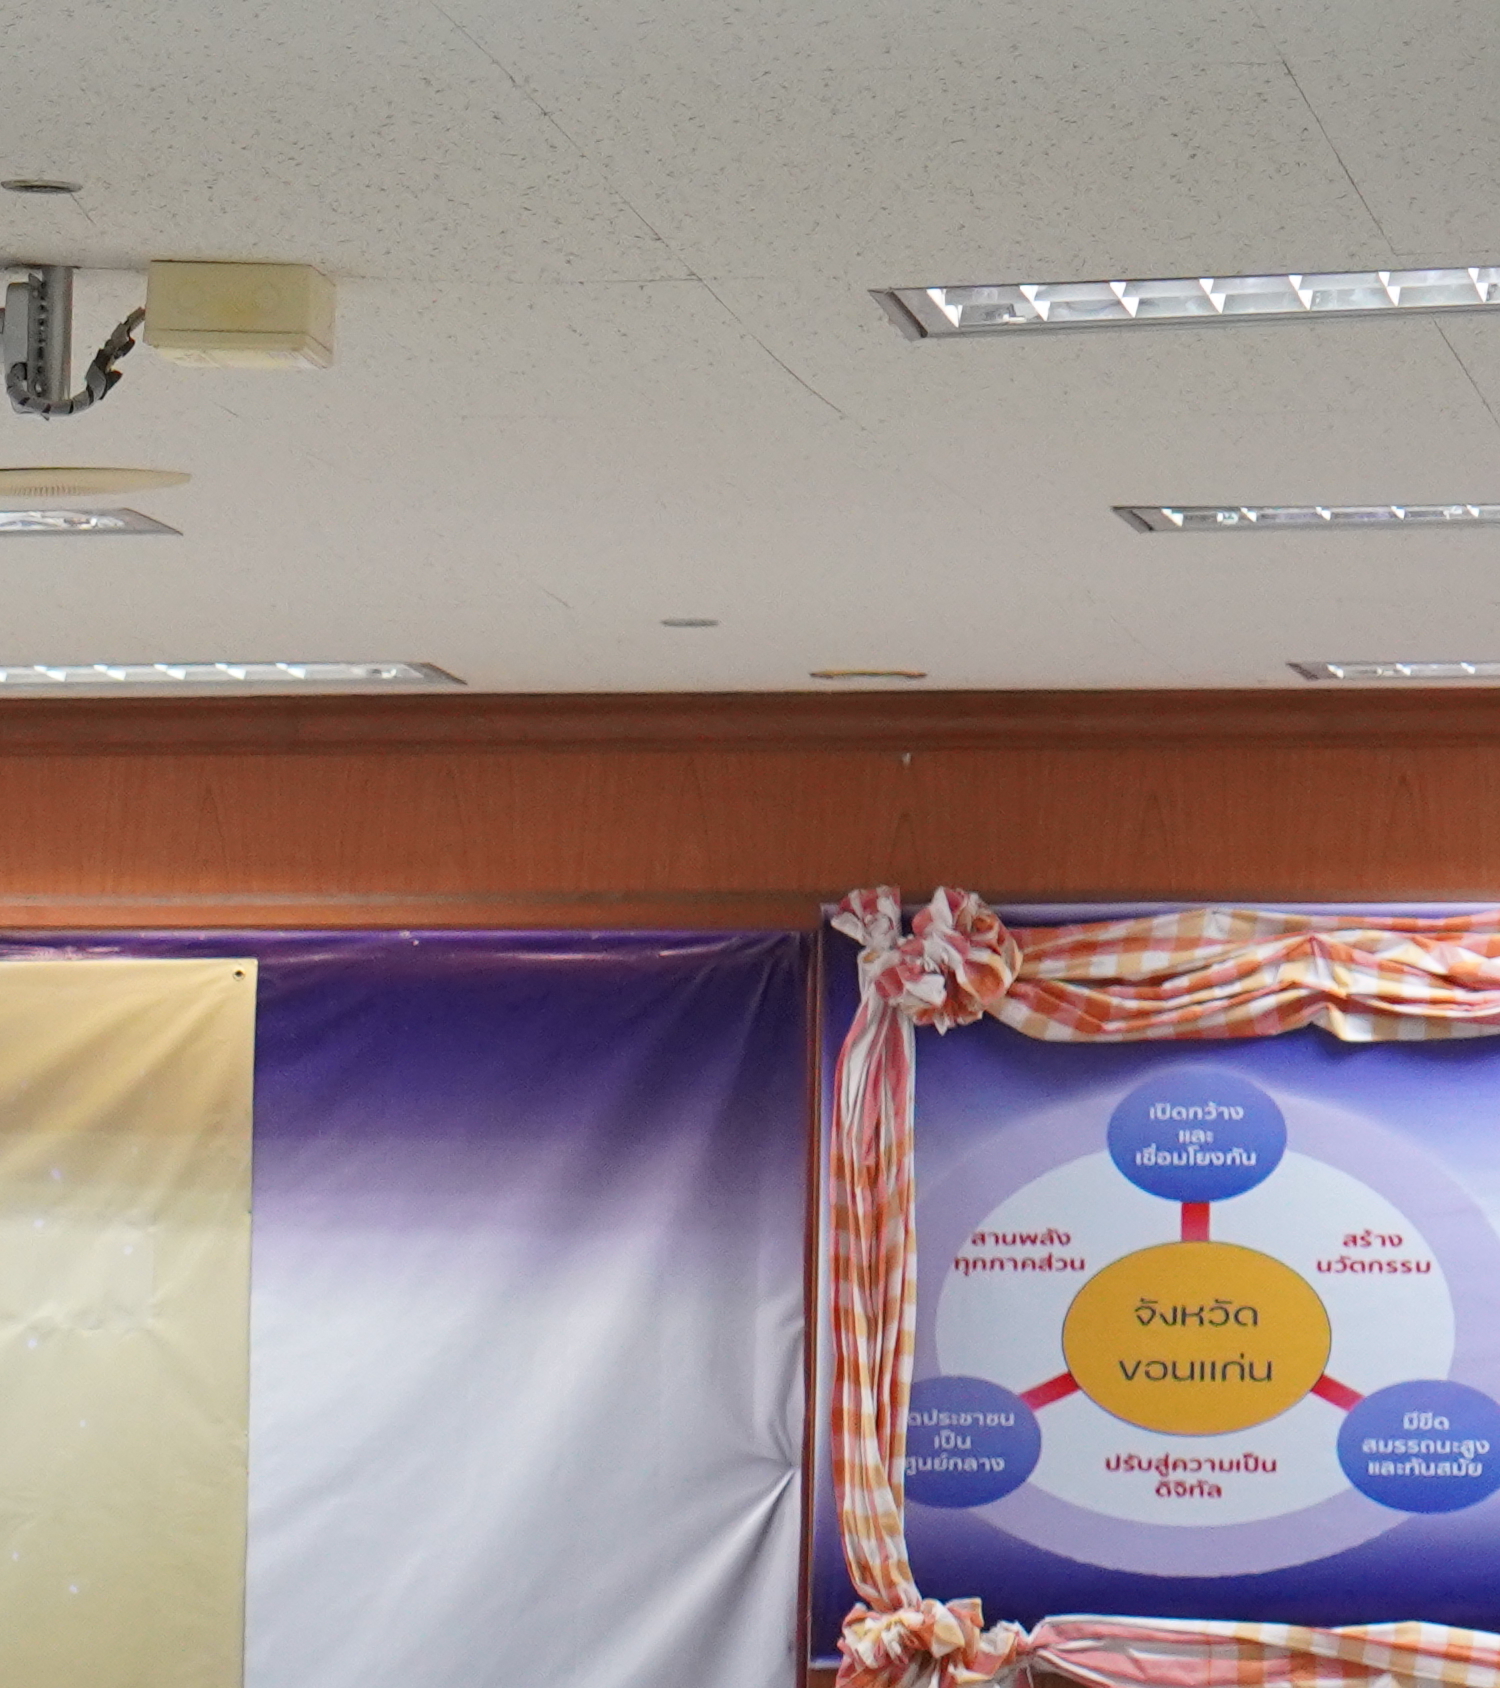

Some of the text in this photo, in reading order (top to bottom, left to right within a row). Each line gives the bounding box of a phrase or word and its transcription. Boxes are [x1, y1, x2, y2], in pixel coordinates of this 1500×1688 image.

[1149, 1101, 1244, 1121] เปิดกว้าง
[1178, 1129, 1214, 1144] และ
[1135, 1143, 1257, 1167] เชื่อมโยงกัน
[970, 1227, 1071, 1247] สานพลัง
[1342, 1227, 1403, 1249] สร้าง
[954, 1252, 1086, 1276] ทุกภาคส่วน
[1316, 1252, 1431, 1275] นวัตกรรม
[1133, 1298, 1259, 1329] จังหวัด
[1118, 1352, 1273, 1384] ขอนแก่น
[934, 1428, 972, 1450] เป็น
[1362, 1438, 1490, 1459] สมรรถนะสูง
[1104, 1452, 1278, 1477] ปรับสู่ความเป็น
[1155, 1479, 1224, 1500] ดิจิทัล
